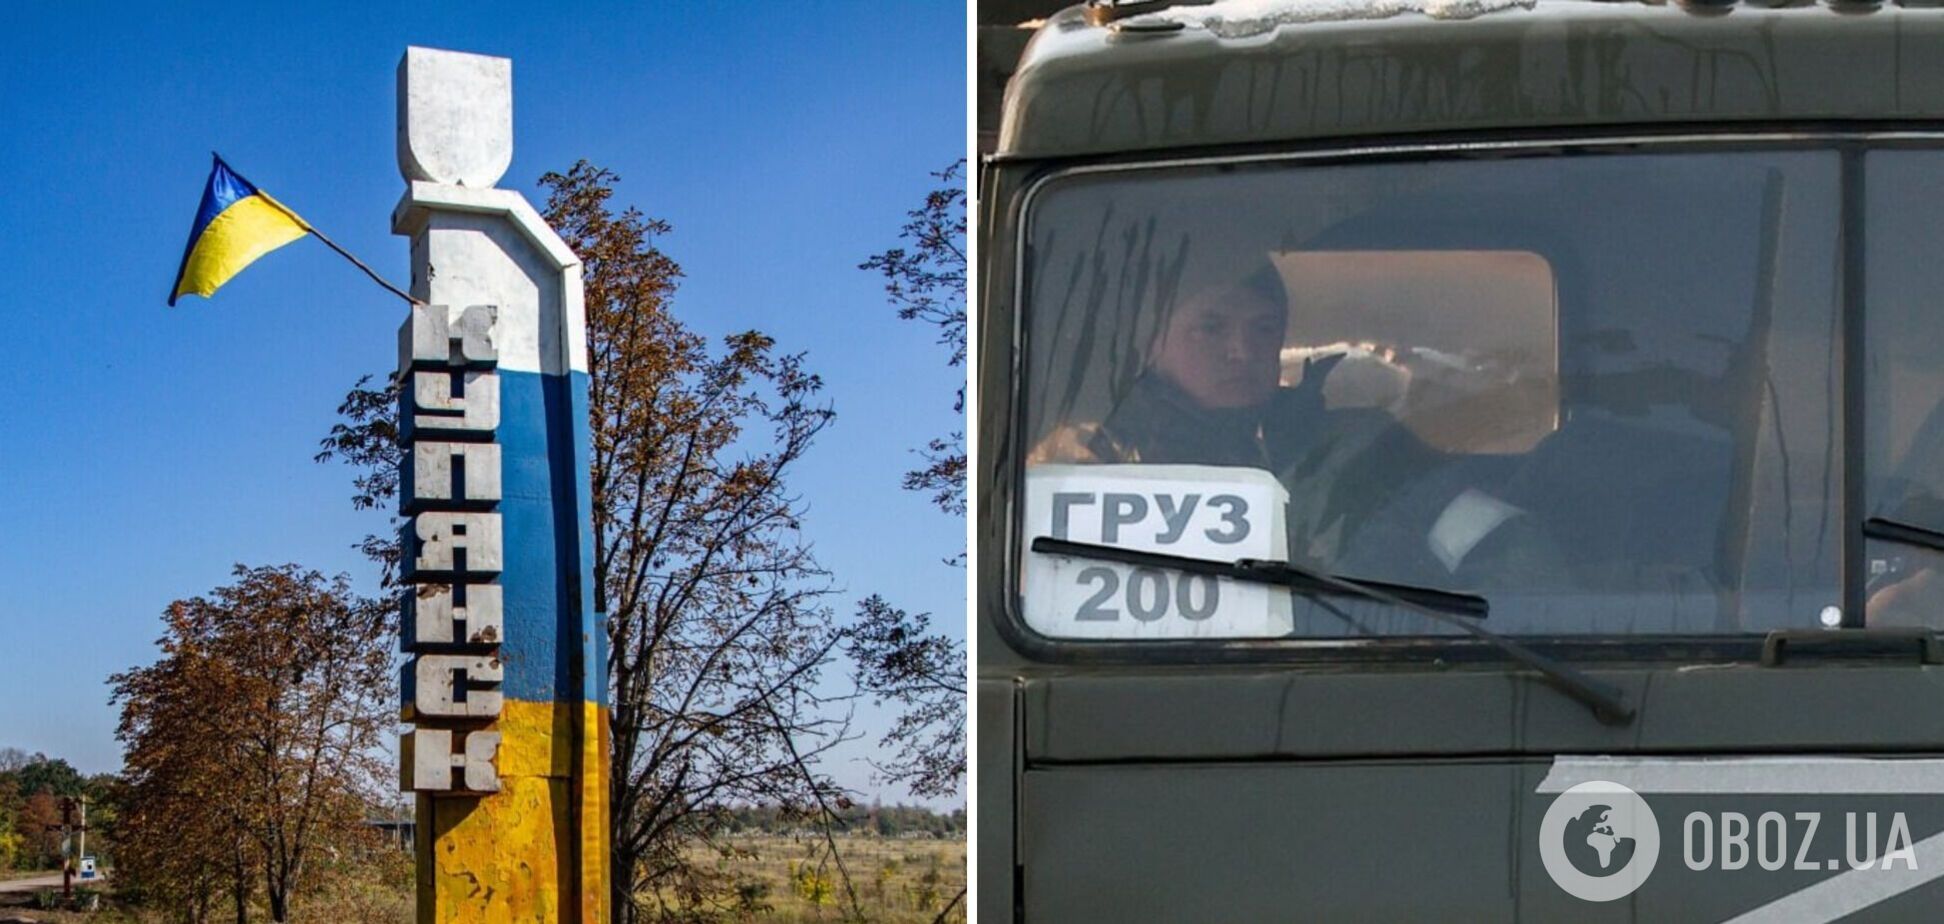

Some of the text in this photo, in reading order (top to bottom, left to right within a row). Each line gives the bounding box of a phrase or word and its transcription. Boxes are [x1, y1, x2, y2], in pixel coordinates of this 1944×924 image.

[1051, 492, 1251, 545] ГРУЗ
[411, 304, 504, 792] КУПЯНСК
[1074, 567, 1220, 622] 200
